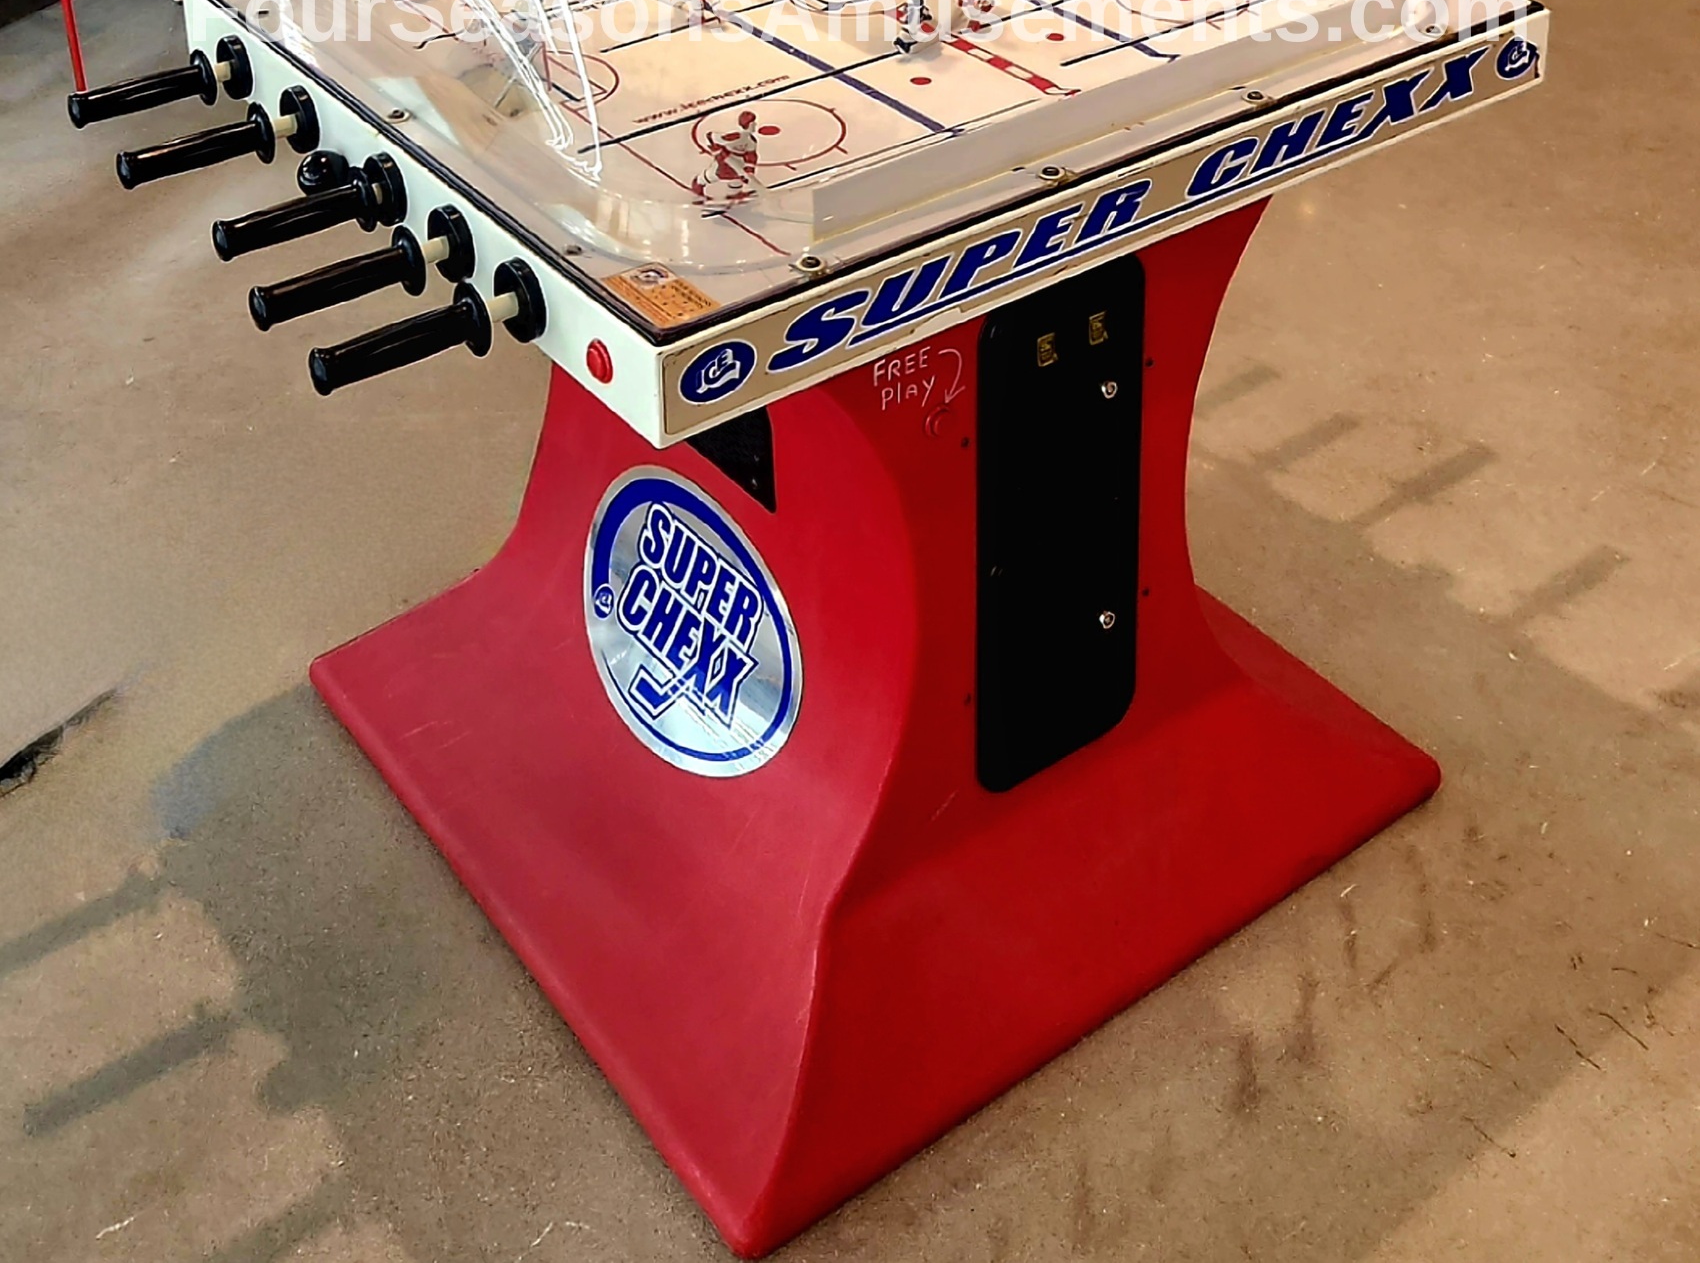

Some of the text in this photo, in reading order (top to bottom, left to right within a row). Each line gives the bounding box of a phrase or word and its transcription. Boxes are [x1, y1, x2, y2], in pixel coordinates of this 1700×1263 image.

[766, 179, 1153, 374] SUPER
[1184, 44, 1493, 200] CHEXX
[873, 345, 931, 387] FREE
[617, 564, 758, 725] CHEXX
[640, 503, 764, 651] SUPER
